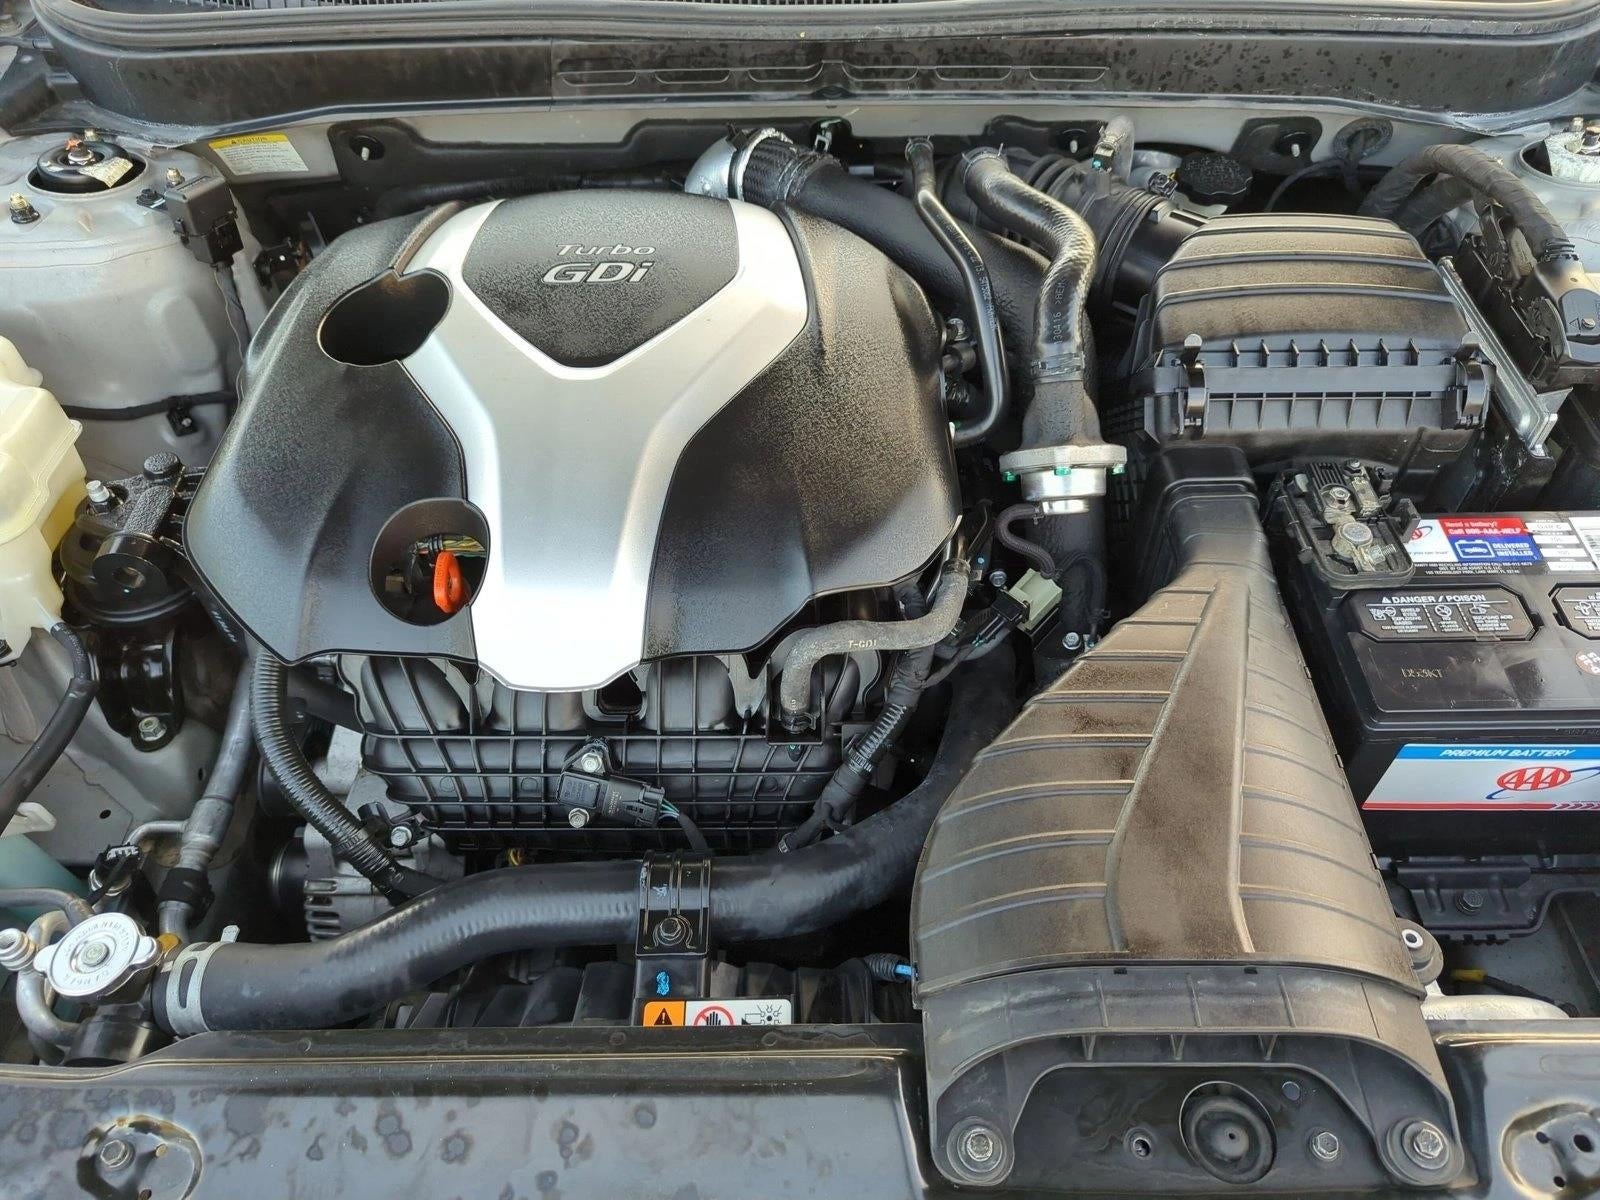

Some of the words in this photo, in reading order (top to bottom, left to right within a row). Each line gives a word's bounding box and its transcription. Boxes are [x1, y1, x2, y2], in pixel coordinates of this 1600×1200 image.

[556, 243, 656, 256] Turbo
[541, 260, 655, 284] GDi
[1391, 595, 1436, 604] DANGER
[1445, 594, 1487, 602] POISON
[1439, 749, 1509, 757] PREMIUM
[1508, 749, 1576, 757] BATTERY
[1501, 767, 1567, 791] AAA
